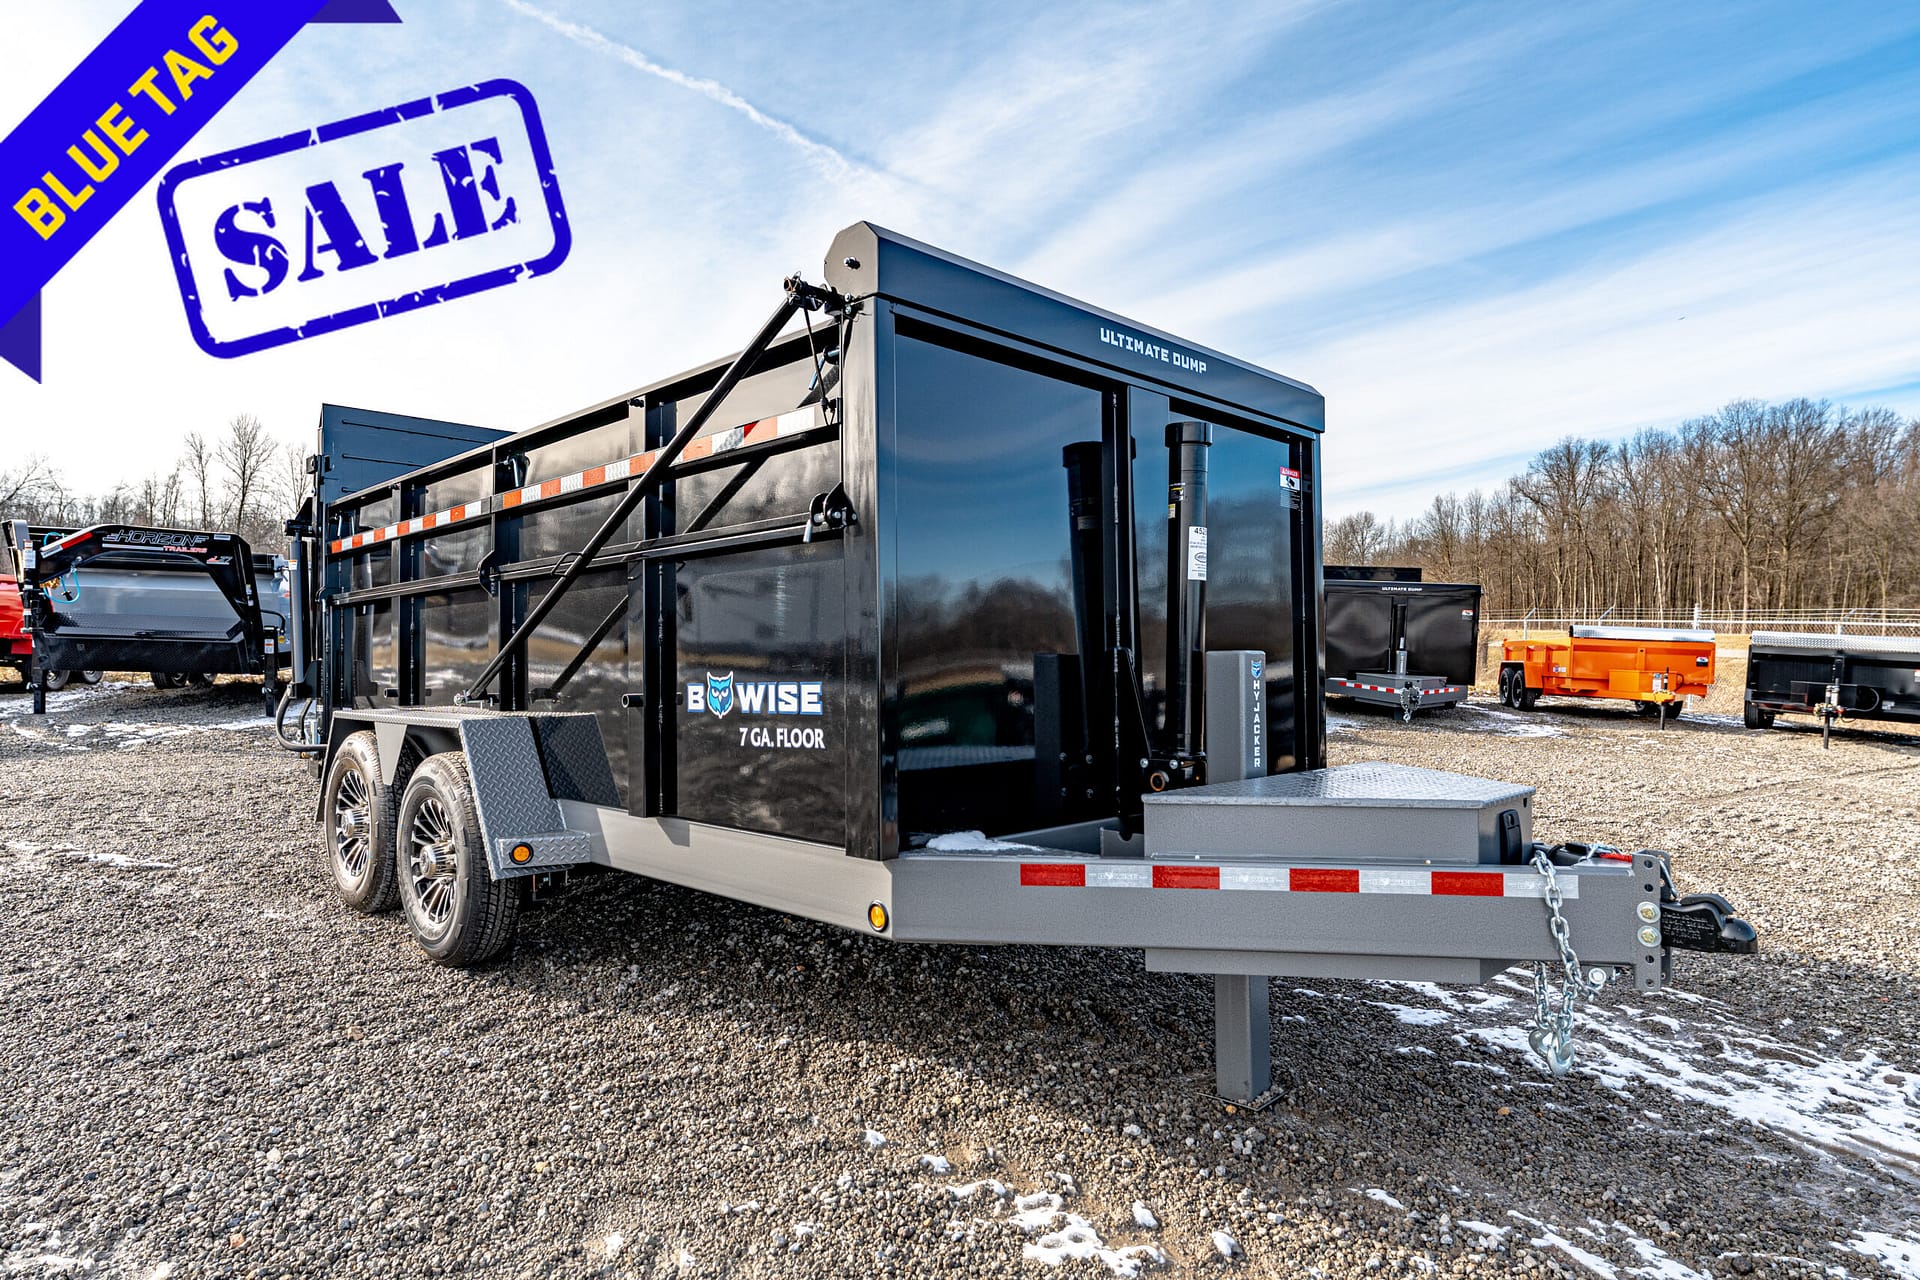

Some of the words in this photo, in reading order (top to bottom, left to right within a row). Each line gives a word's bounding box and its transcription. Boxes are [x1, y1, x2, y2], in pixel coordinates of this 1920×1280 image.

[1100, 327, 1170, 363] ULTIMATE
[1172, 351, 1208, 374] DUMP
[108, 529, 208, 547] HORIZON
[163, 545, 208, 553] TRAILERS
[1253, 680, 1261, 767] HYJACKER
[739, 727, 748, 747] 7
[750, 727, 775, 748] GA.
[776, 728, 826, 749] FLOOR
